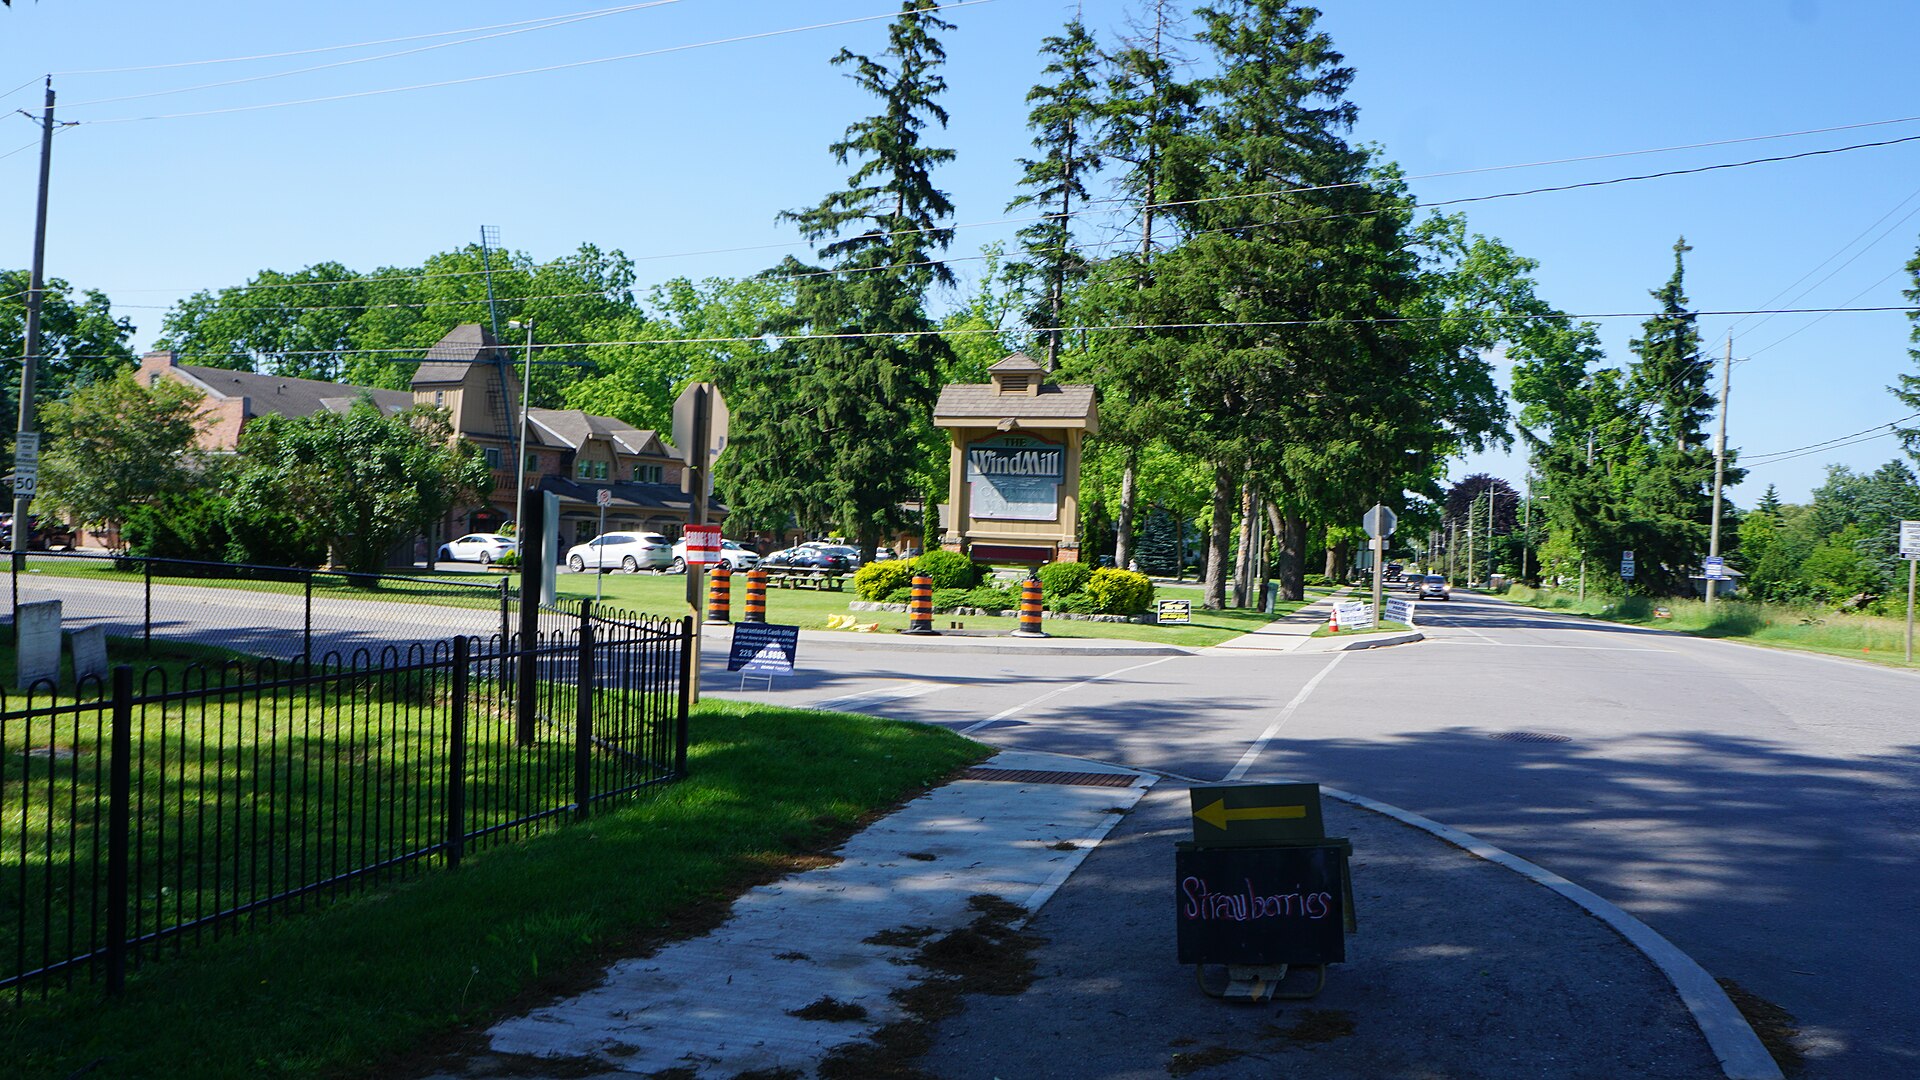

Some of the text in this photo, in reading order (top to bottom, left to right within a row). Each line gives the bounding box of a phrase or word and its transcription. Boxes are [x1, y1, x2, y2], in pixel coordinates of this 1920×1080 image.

[1003, 438, 1027, 447] THE
[971, 450, 1059, 476] WindMill
[16, 477, 34, 490] 50
[1622, 566, 1633, 574] 50
[768, 628, 780, 636] Cash
[1182, 876, 1332, 921] Strawberries
